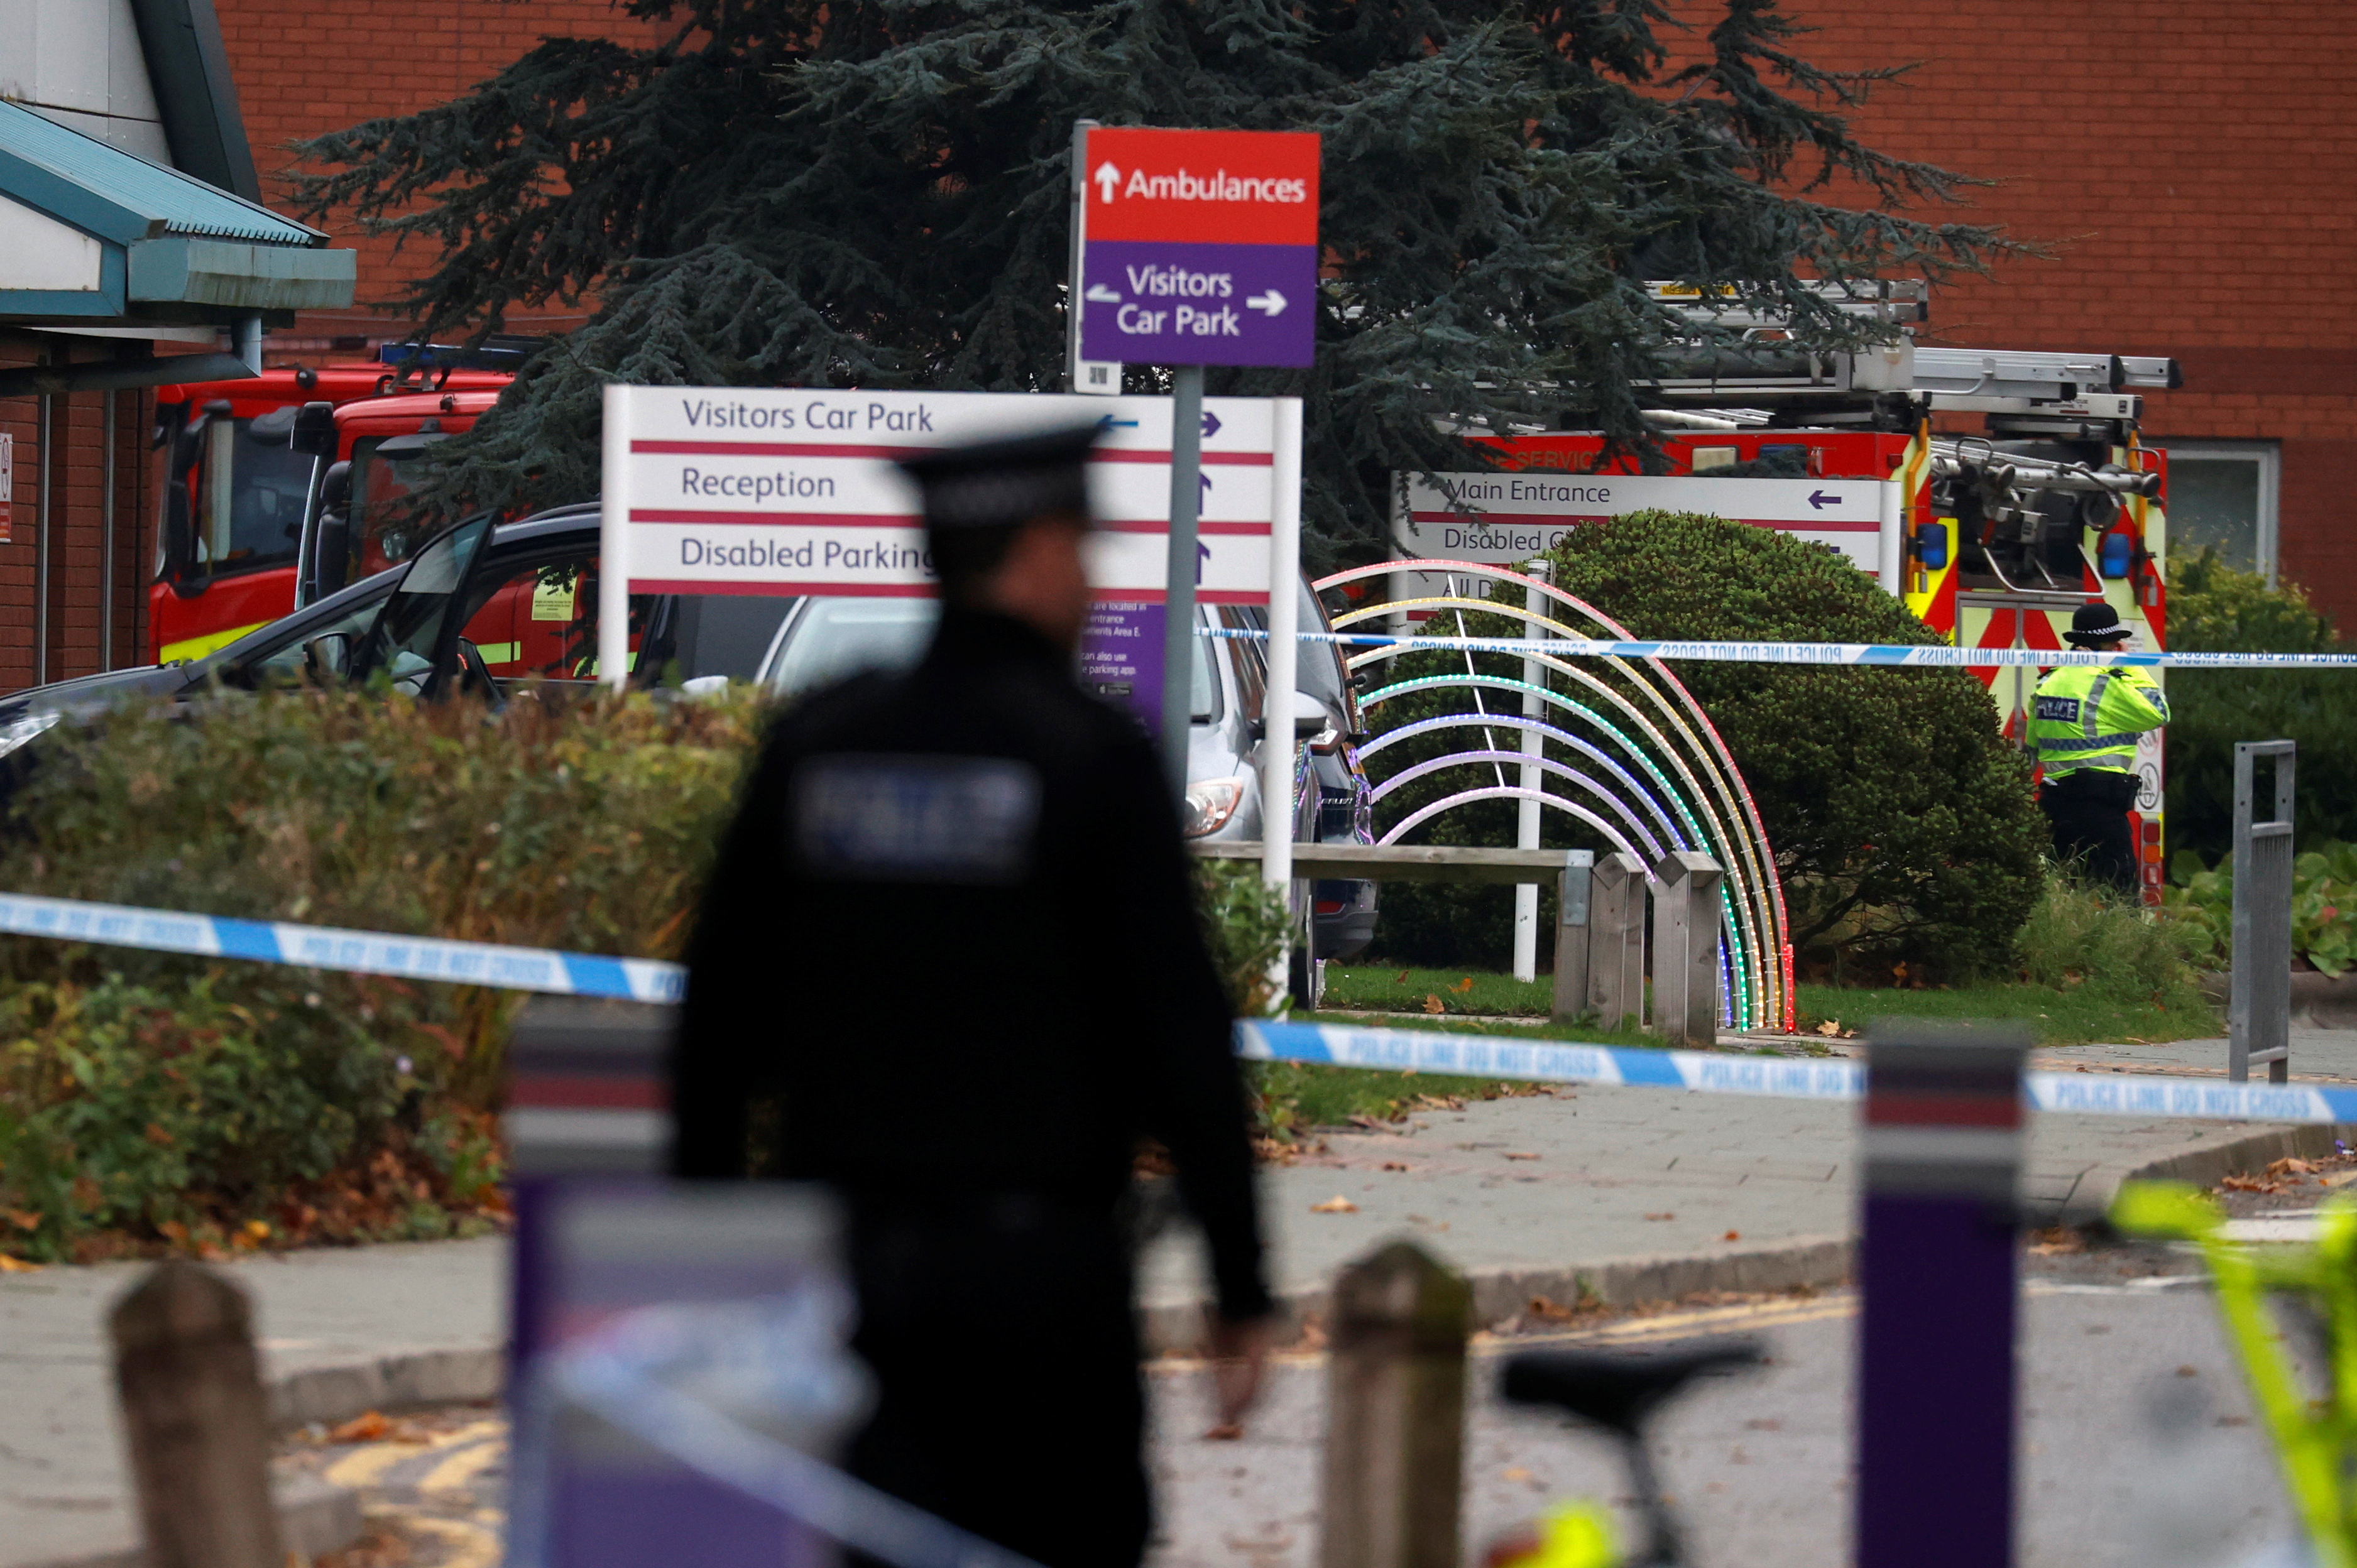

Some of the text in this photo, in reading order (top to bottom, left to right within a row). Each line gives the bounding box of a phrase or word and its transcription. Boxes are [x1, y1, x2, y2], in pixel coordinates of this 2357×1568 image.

[1125, 168, 1306, 204] Ambulances
[1126, 264, 1233, 298] Visitors
[1117, 304, 1240, 336] Car Park
[682, 400, 934, 432] Visitors Car Park
[1515, 450, 1609, 471] SERVIC
[682, 467, 835, 503] Reception
[1446, 479, 1611, 503] Main Entrance
[1445, 528, 1541, 551] Disabled
[681, 538, 936, 576] Disabled Parking
[1089, 665, 1118, 676] parking
